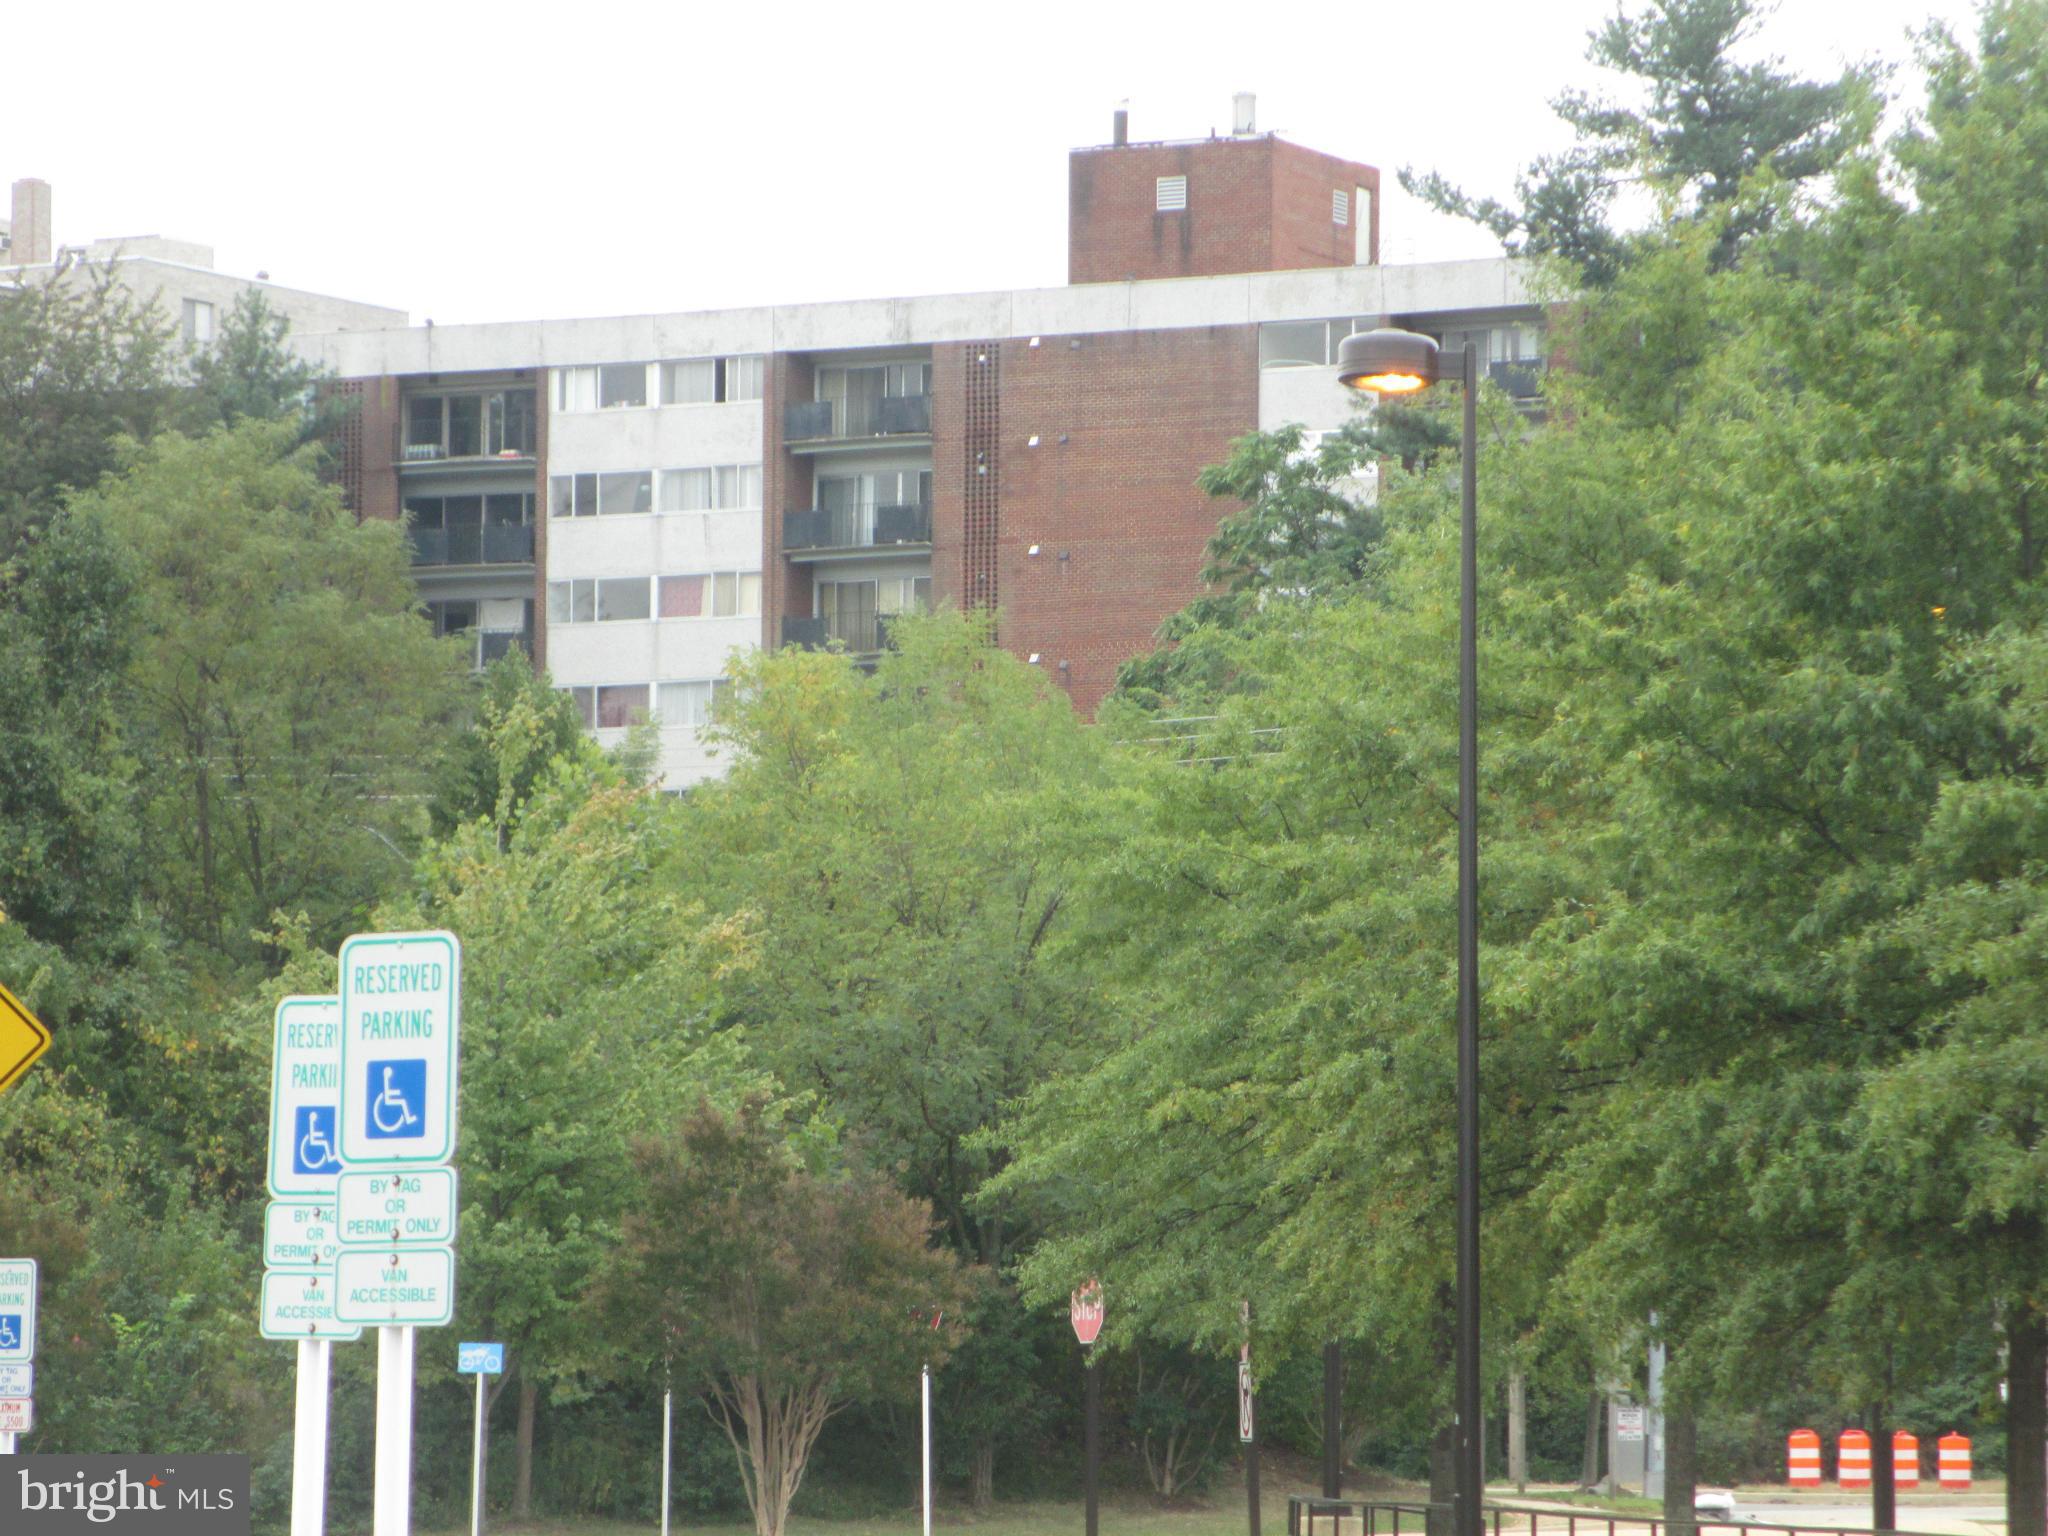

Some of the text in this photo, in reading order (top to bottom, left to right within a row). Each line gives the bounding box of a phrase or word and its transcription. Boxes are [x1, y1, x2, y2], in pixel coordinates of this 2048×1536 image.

[354, 963, 442, 994] RESERVED
[361, 1009, 433, 1040] PARKING
[370, 1179, 388, 1194] BY
[385, 1199, 406, 1214] OR
[294, 1210, 310, 1223] BY
[347, 1217, 441, 1234] PERMIT ONLY
[306, 1228, 325, 1240] OR
[274, 1245, 318, 1258] PERMIT
[381, 1269, 407, 1283] VAN
[303, 1288, 325, 1301] VAN
[349, 1287, 437, 1304] ACCESSIBLE
